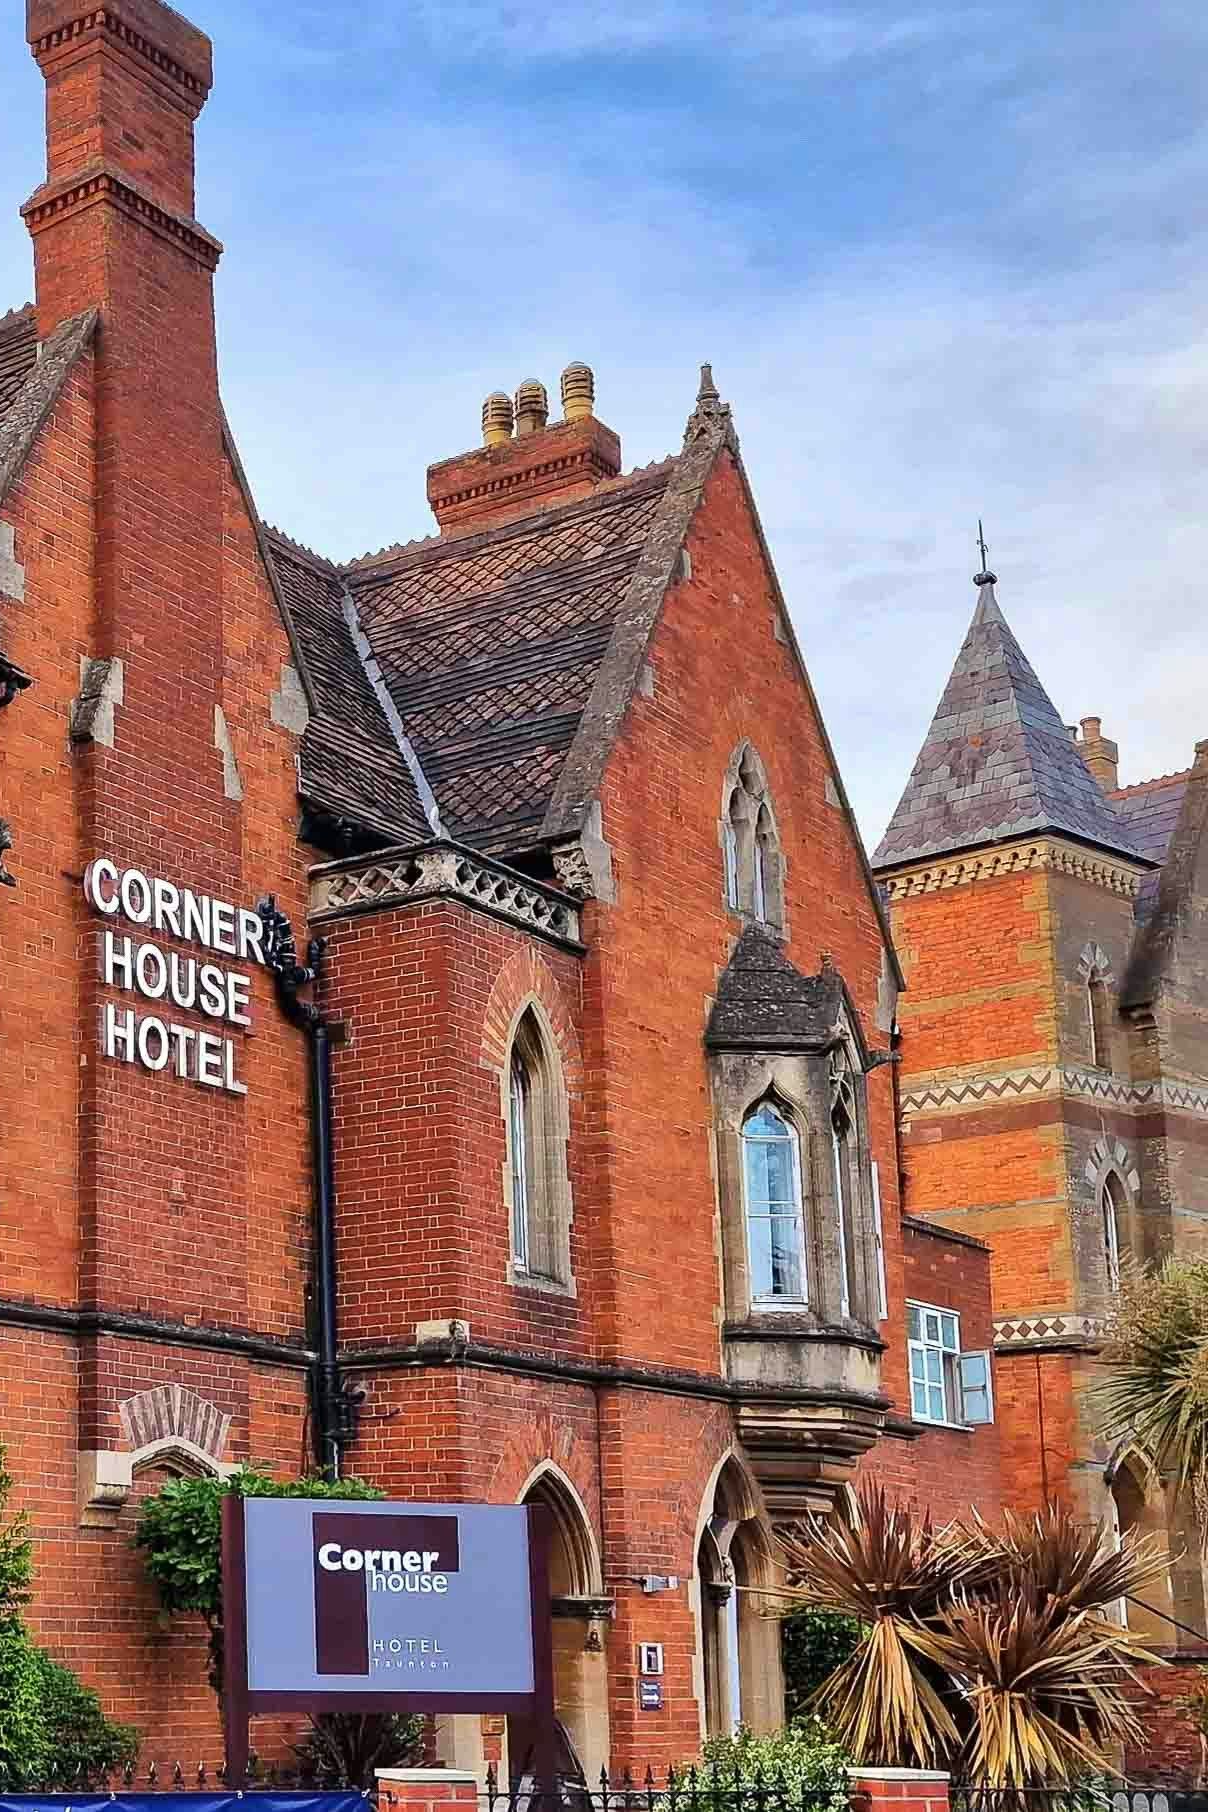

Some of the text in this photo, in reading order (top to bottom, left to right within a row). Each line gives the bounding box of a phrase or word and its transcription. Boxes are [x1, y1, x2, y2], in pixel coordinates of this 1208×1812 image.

[87, 857, 266, 965] CORNER
[103, 929, 252, 1026] HOUSE
[105, 1002, 248, 1095] HOTEL
[318, 1542, 440, 1573] Corner
[371, 1566, 448, 1593] house
[372, 1639, 445, 1653] HOTEL
[372, 1658, 449, 1669] Taunton
